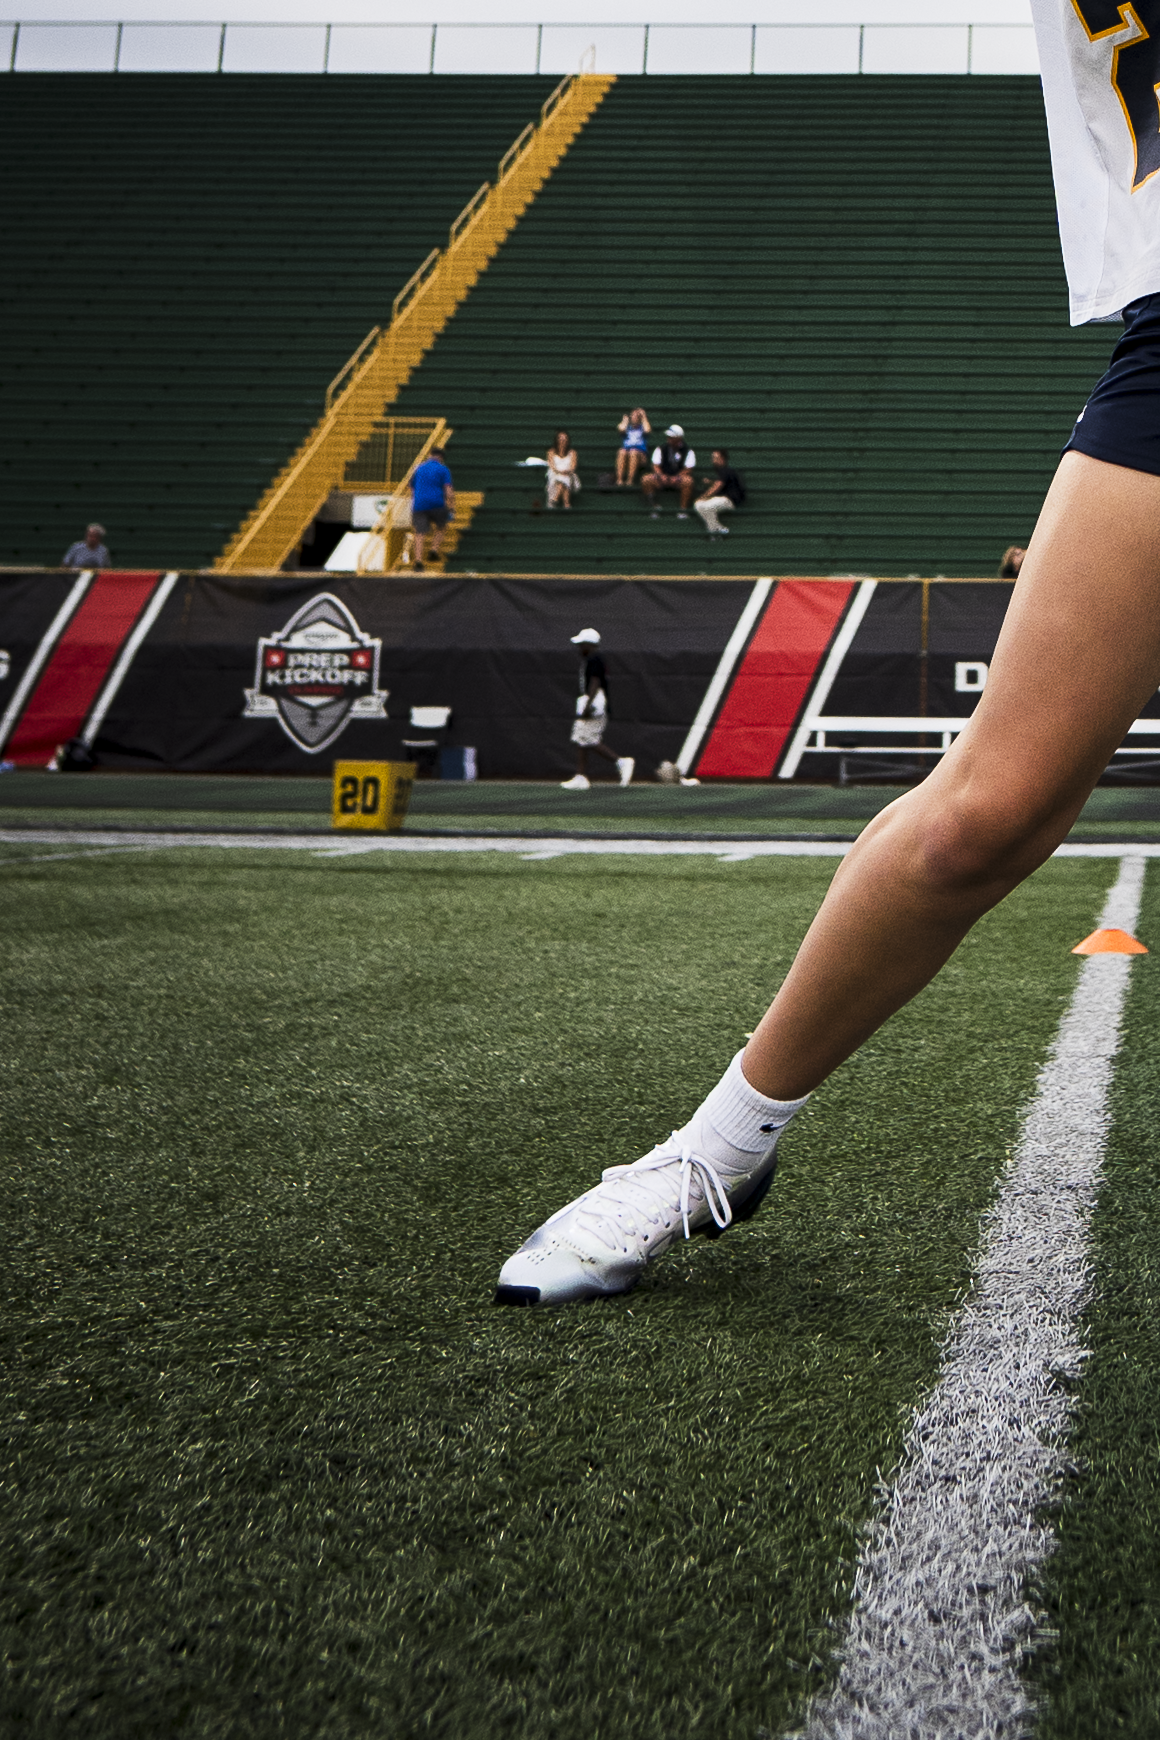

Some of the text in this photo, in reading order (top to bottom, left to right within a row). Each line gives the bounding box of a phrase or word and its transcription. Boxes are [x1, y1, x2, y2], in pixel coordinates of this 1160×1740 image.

[288, 653, 349, 667] PREP
[266, 668, 368, 685] KICKOFF
[340, 775, 381, 816] 20
